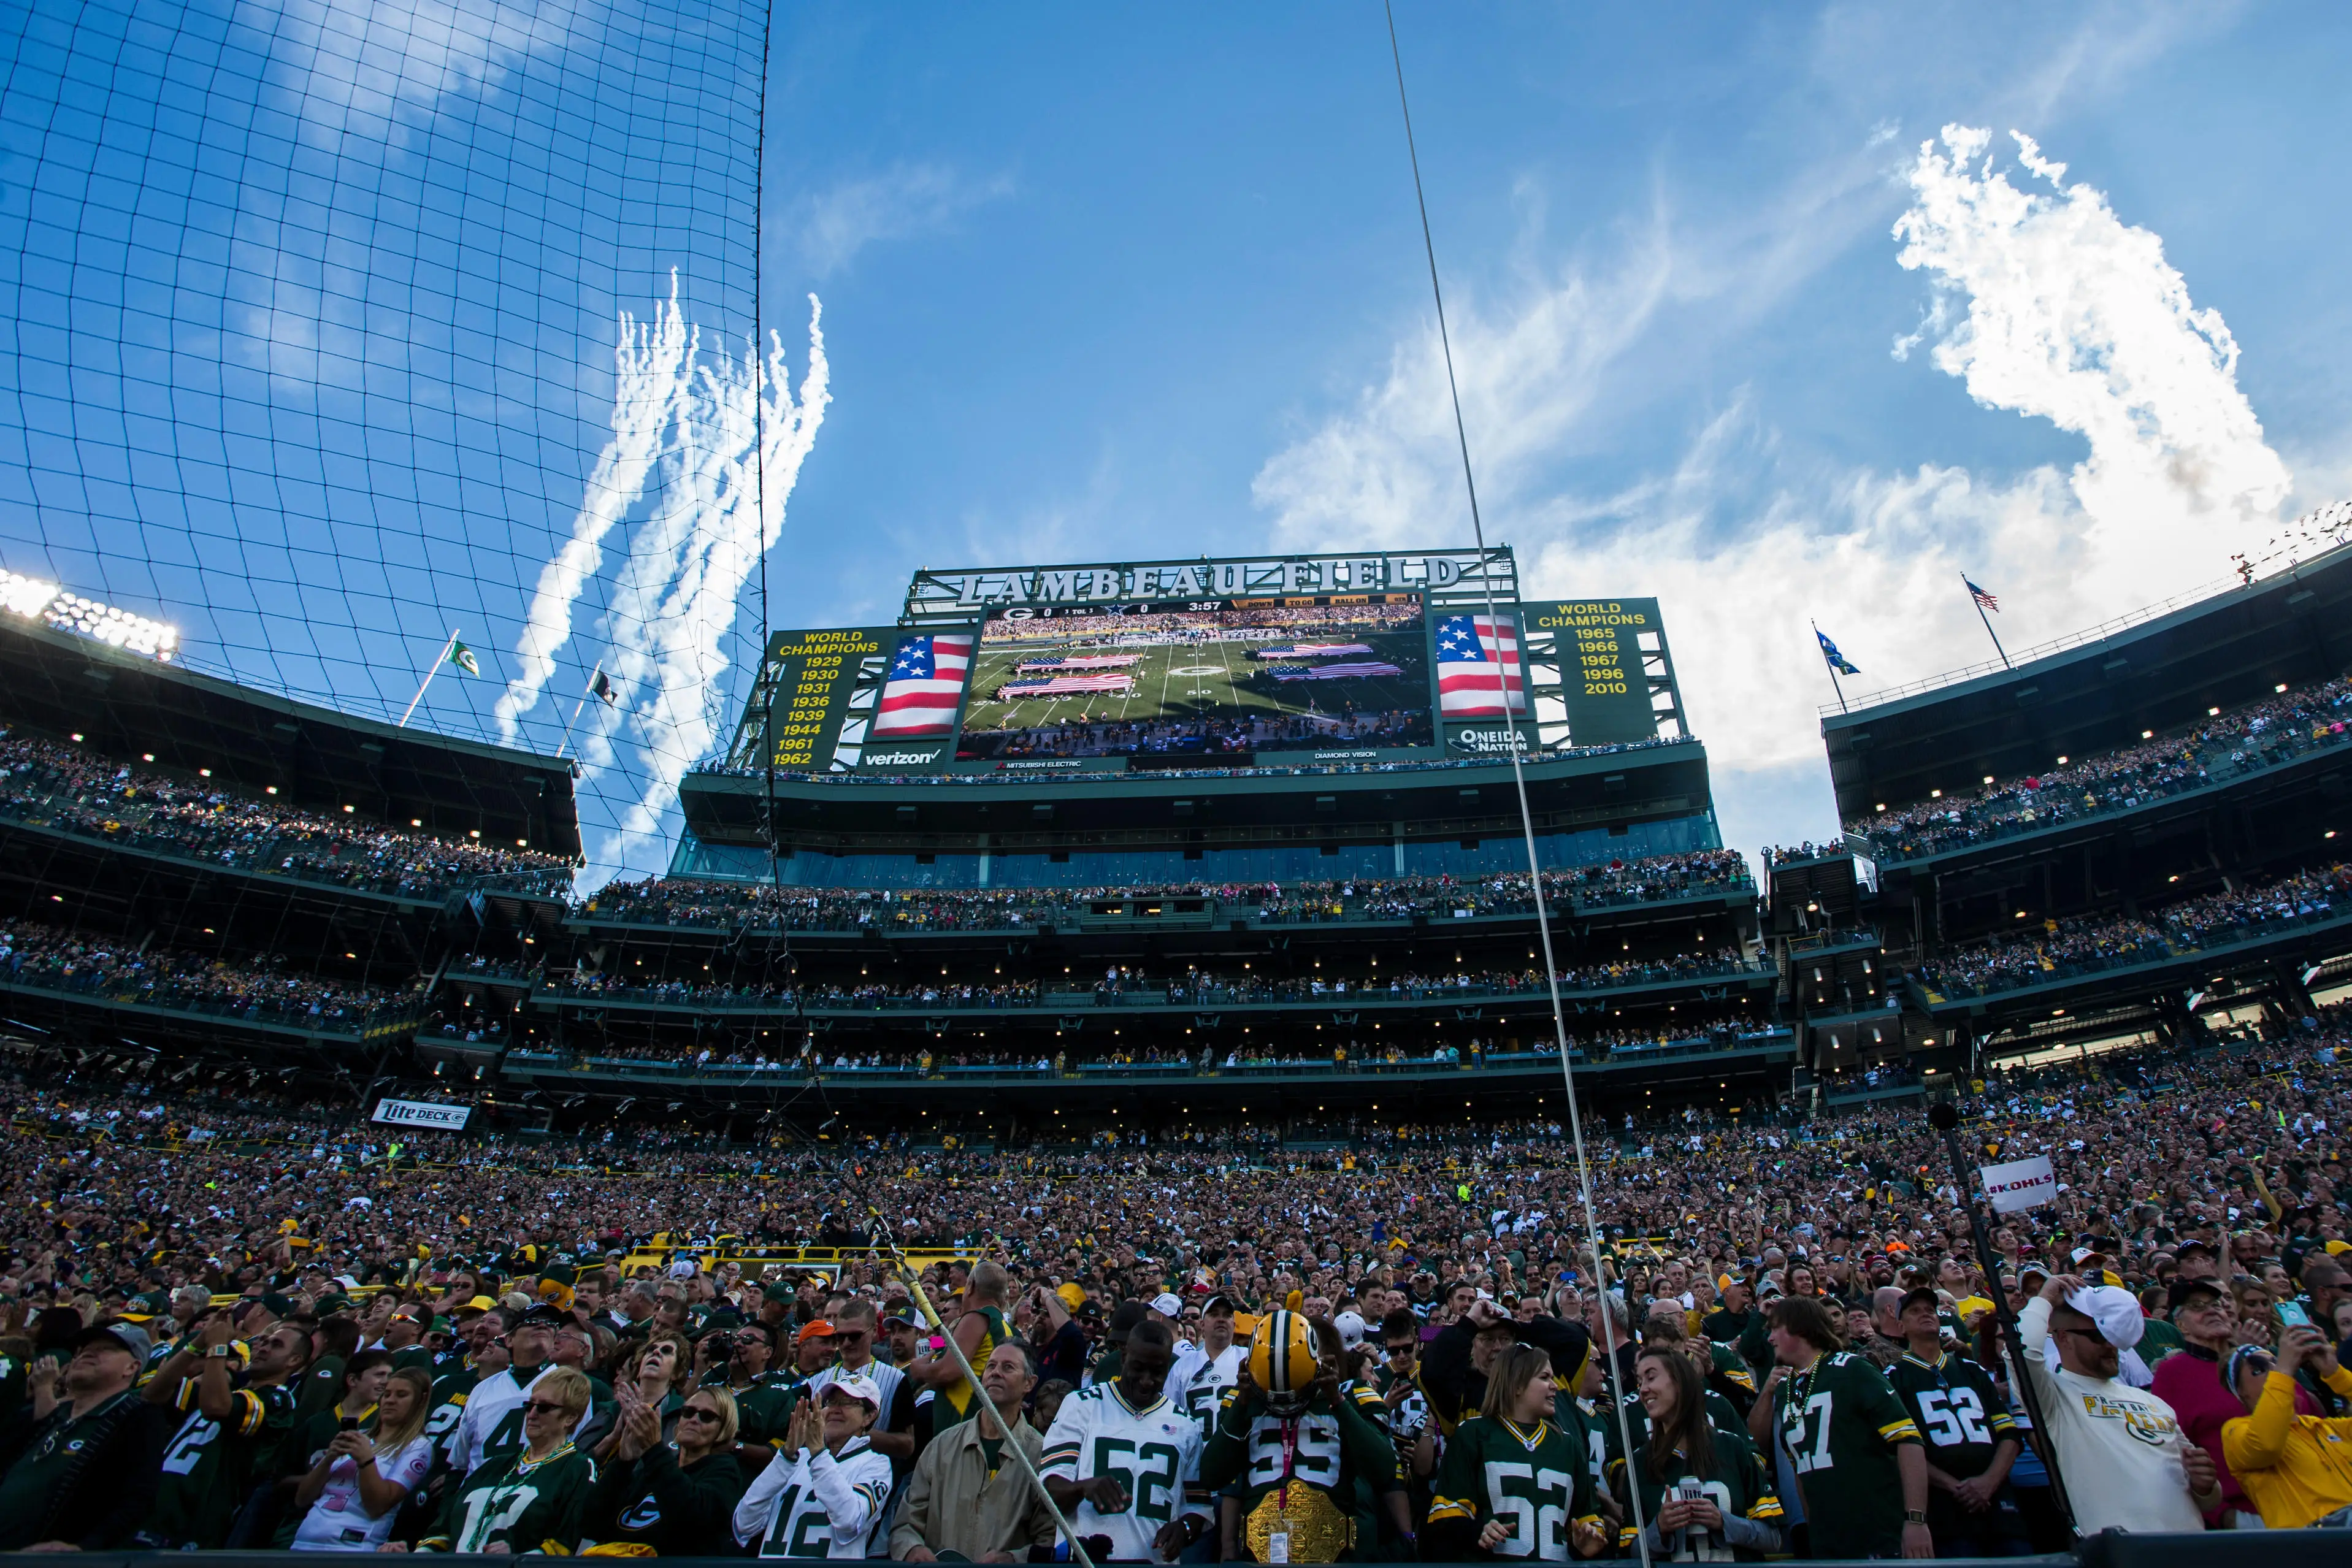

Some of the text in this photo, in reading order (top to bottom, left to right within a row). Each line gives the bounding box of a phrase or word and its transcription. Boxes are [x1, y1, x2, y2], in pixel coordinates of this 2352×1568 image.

[959, 557, 1461, 602] LAMBEAU FIELD
[1044, 608, 1051, 617] 0
[1189, 602, 1221, 611] 3:57
[1557, 603, 1621, 615] WORLD
[1538, 614, 1645, 627] CHAMPIONS
[805, 632, 862, 643] WORLD
[1575, 628, 1615, 639] 1965
[780, 642, 878, 656] CHAMPIONS
[1577, 641, 1618, 652] 1966
[806, 656, 843, 667] 1929
[1580, 655, 1618, 666] 1967
[802, 669, 839, 681] 1930
[1582, 668, 1624, 680] 1996
[797, 683, 830, 694] 1931
[1585, 683, 1627, 694] 2010
[792, 696, 830, 708] 1936
[788, 709, 825, 721] 1939
[784, 724, 821, 736] 1944
[1461, 730, 1526, 743] ONEIDA
[779, 738, 814, 750] 1961
[774, 753, 812, 765] 1962
[866, 752, 930, 765] verizon
[381, 1103, 416, 1121] Lite
[416, 1109, 451, 1121] DECK
[1990, 1174, 2051, 1194] #KOHLS
[1916, 1387, 1993, 1447] 52
[1782, 1391, 1834, 1474] 27
[1094, 1437, 1179, 1521] 52
[1485, 1461, 1574, 1561] 52
[762, 1484, 831, 1558] 12
